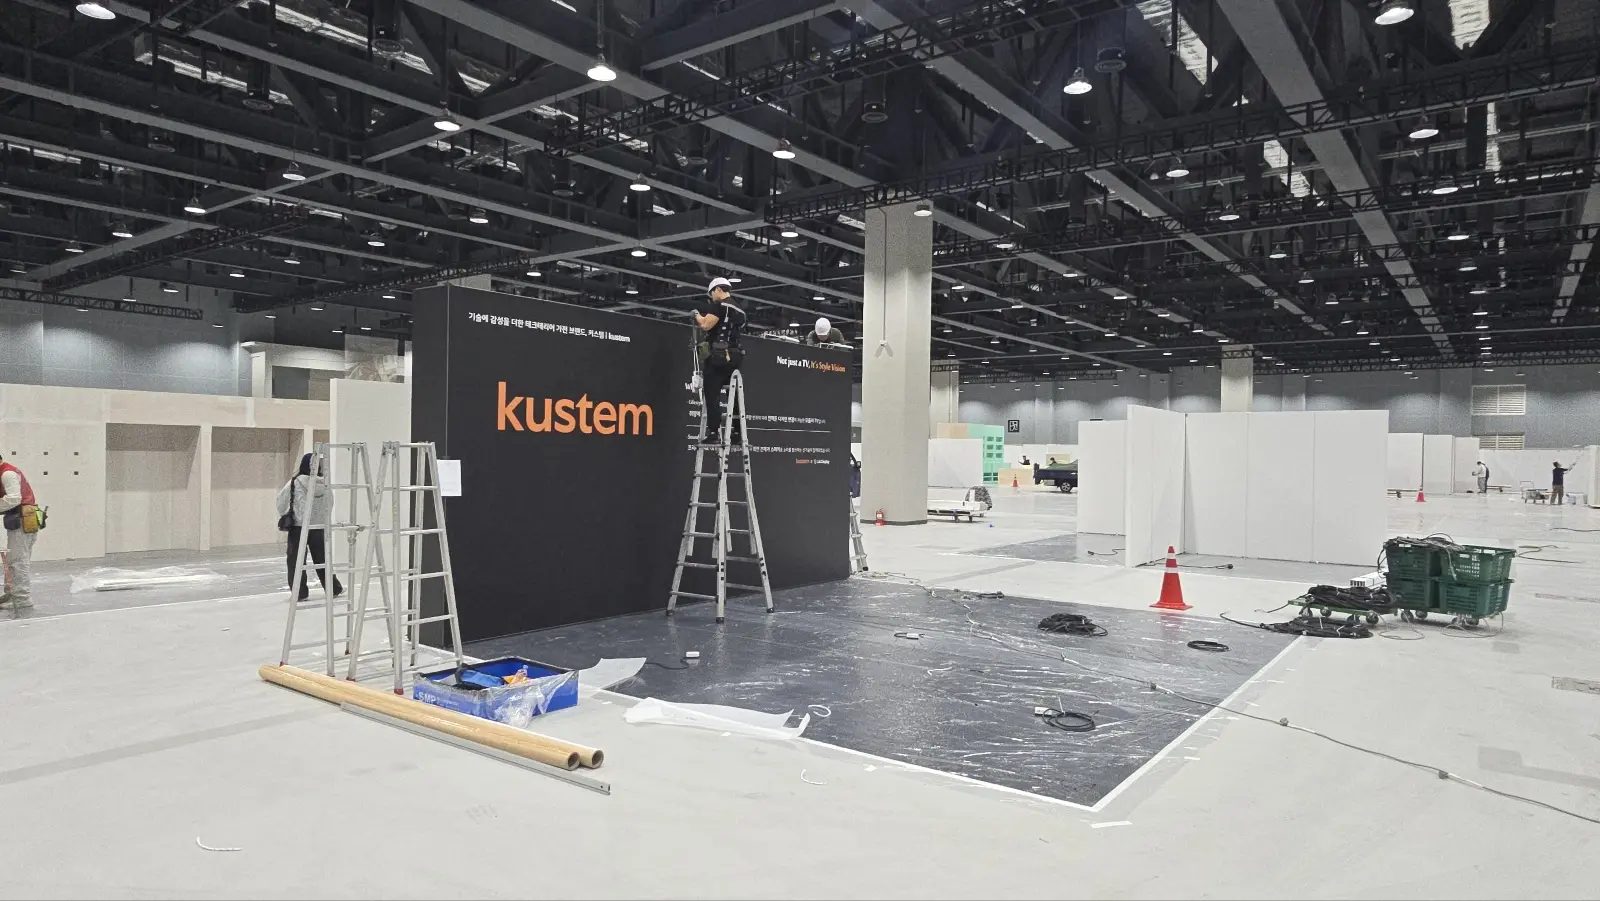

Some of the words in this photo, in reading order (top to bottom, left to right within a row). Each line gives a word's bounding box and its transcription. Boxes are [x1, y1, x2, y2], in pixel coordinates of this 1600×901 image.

[468, 312, 489, 323] 기술에
[490, 315, 510, 327] 감성을
[511, 318, 524, 329] 더한
[555, 324, 568, 335] 가전
[588, 329, 604, 340] 커스템
[776, 355, 788, 365] Not
[787, 357, 798, 368] just
[819, 361, 831, 373] Style
[831, 363, 846, 373] Vision
[497, 381, 654, 436] kustem
